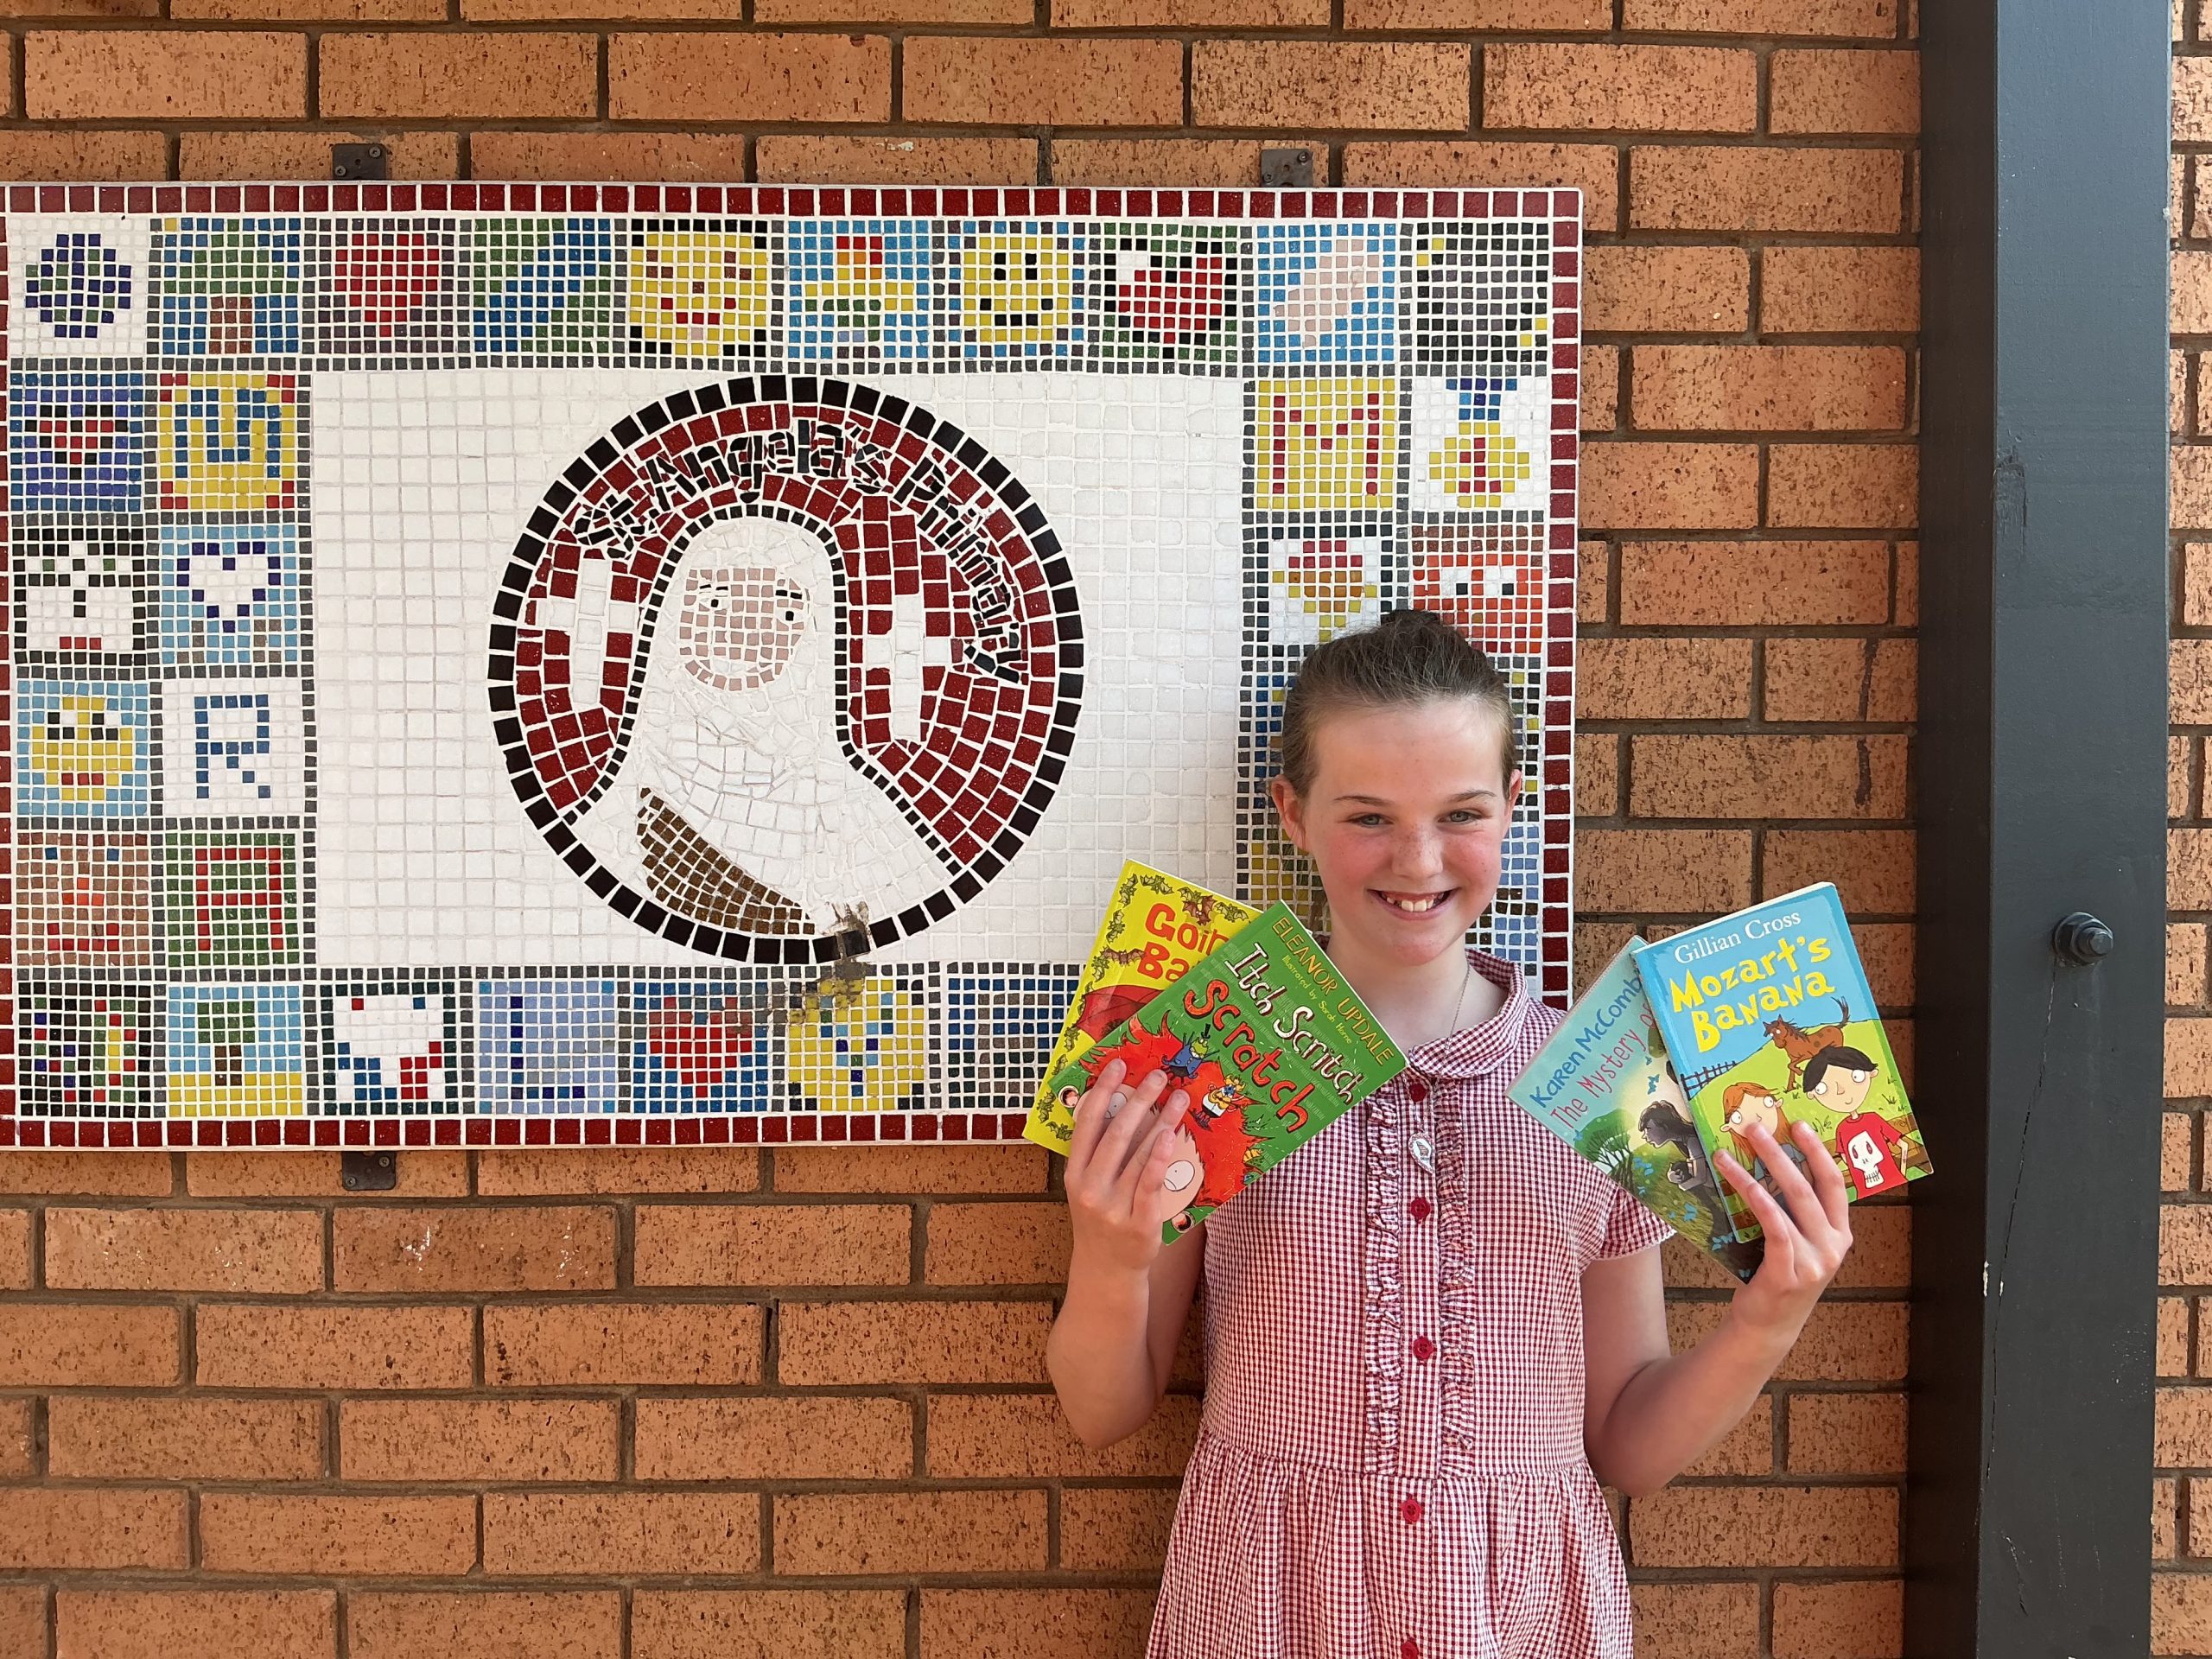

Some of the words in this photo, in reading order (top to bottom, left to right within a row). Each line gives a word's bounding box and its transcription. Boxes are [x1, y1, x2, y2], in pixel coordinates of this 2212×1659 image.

[196, 695, 271, 801] R
[1137, 942, 1190, 982] Ba
[1145, 903, 1230, 956] Goin
[1674, 932, 1742, 963] Gillian
[1745, 912, 1802, 940] Cross
[1272, 917, 1338, 995] ELEANOR
[1338, 997, 1395, 1065] UPDALE
[1282, 954, 1310, 988] Illustrated
[1309, 988, 1318, 1003] by
[1318, 1001, 1336, 1024] Sarah
[1575, 969, 1643, 1053] McComb
[1669, 936, 1832, 1014] Mozart's
[1183, 979, 1318, 1133] Scratch
[1224, 943, 1286, 1016] Itch
[1273, 1006, 1364, 1105] Scritch
[1550, 1097, 1589, 1128] The
[1576, 1028, 1647, 1098] Mystery
